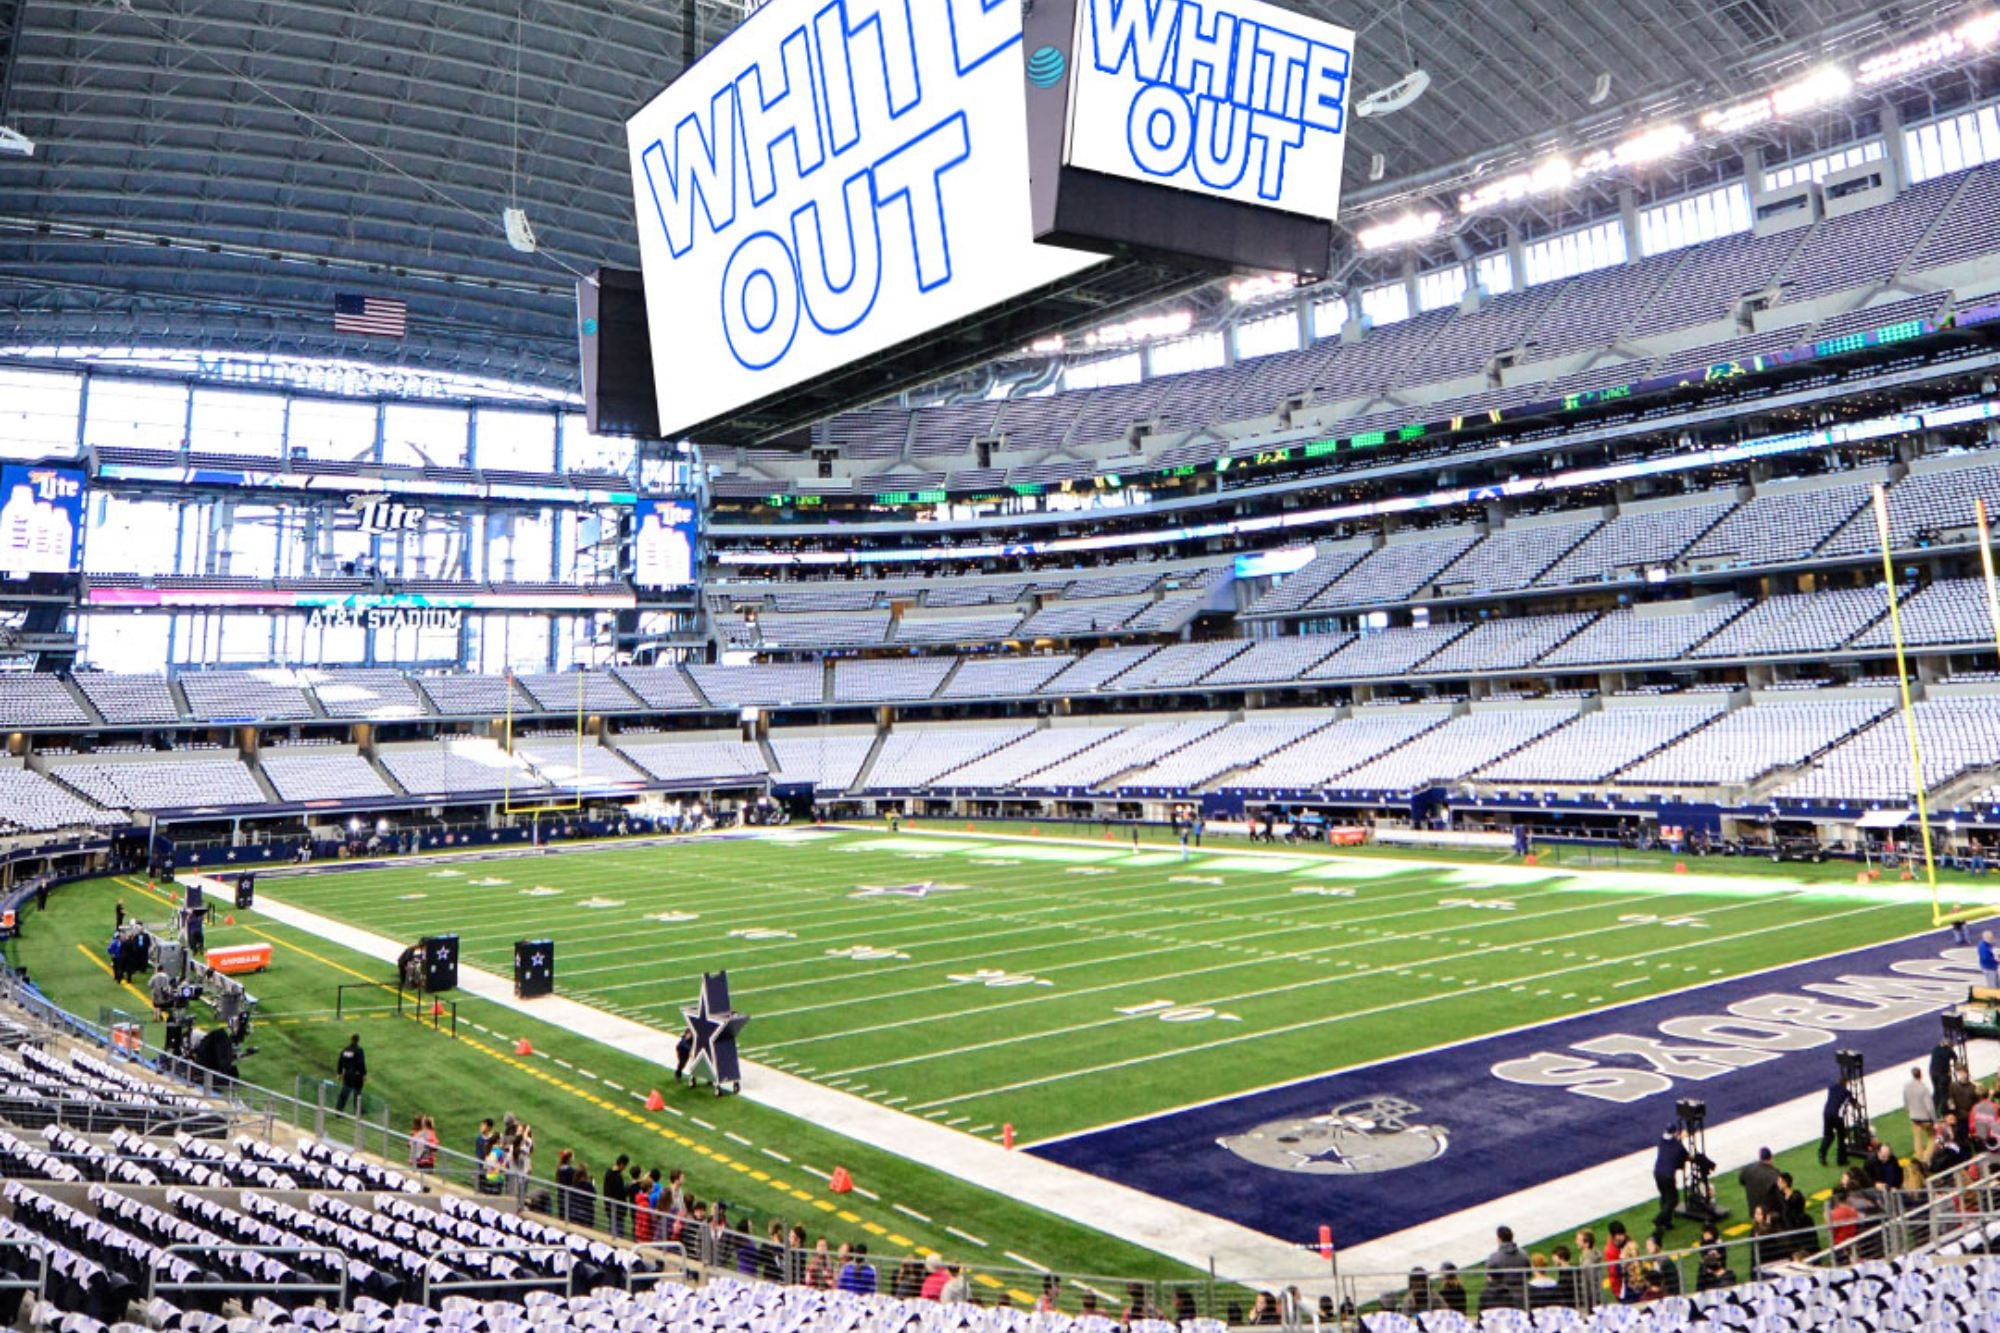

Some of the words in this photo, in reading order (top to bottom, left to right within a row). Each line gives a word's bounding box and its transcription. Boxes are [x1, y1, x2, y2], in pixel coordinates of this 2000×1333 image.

[1090, 0, 1350, 134] WHITE
[1126, 82, 1305, 201] OUT
[721, 110, 971, 371] OUT
[357, 501, 425, 535] Lite
[307, 605, 363, 629] AT&T
[367, 608, 463, 629] STADIUM
